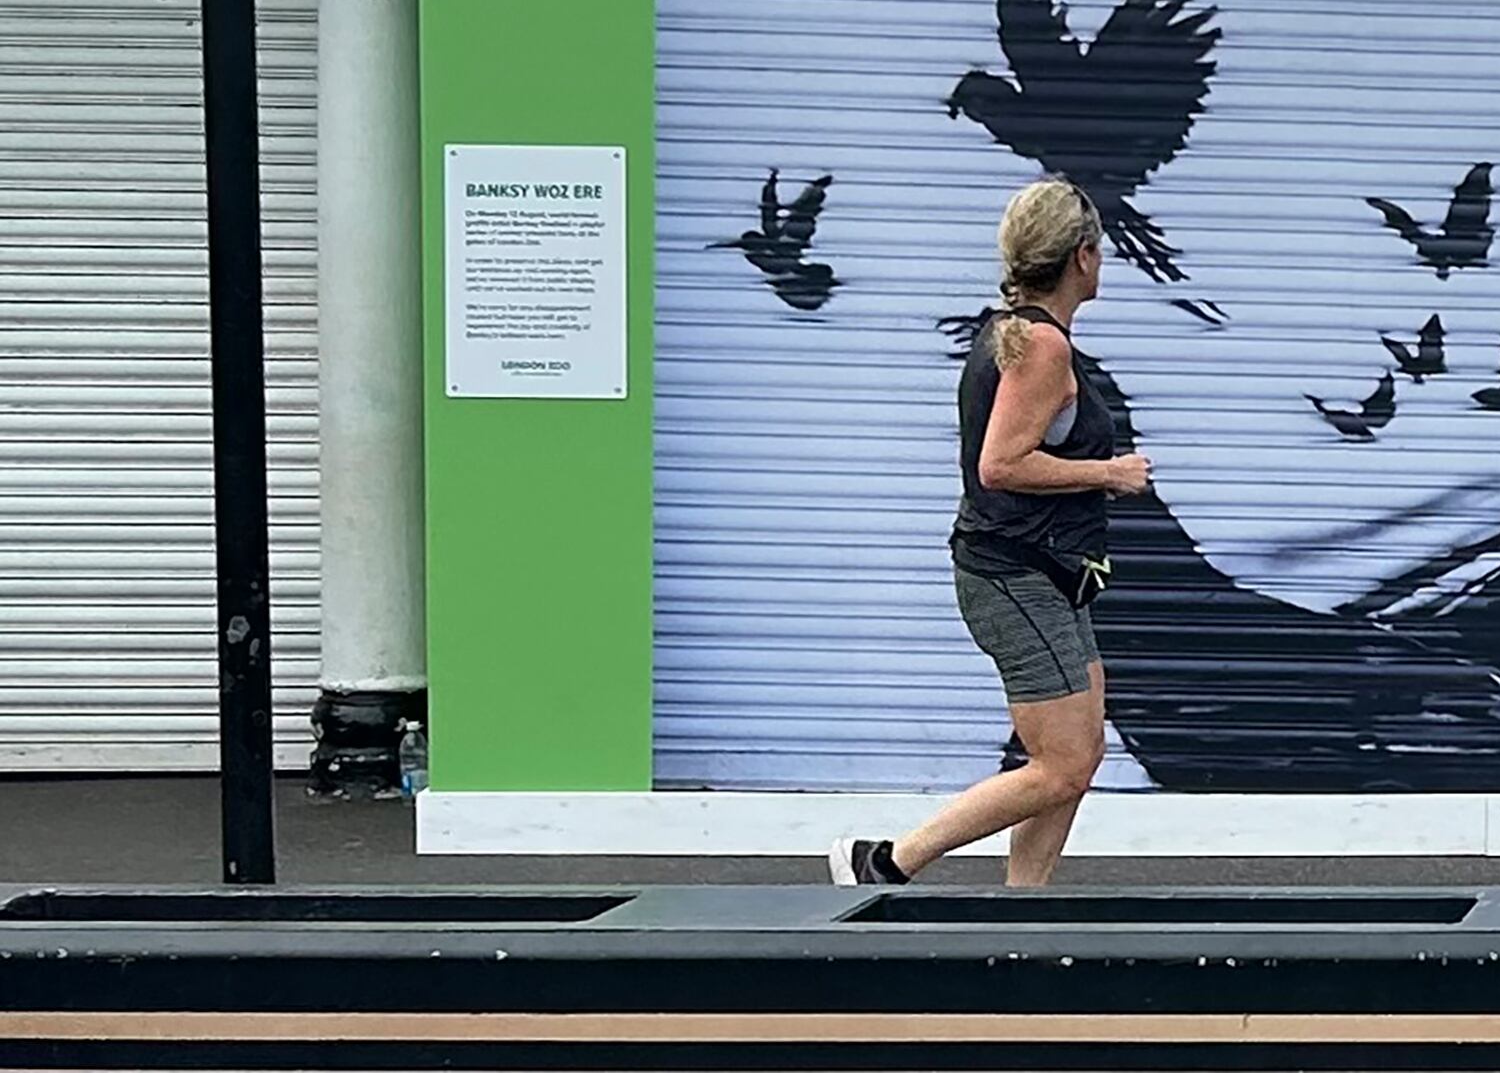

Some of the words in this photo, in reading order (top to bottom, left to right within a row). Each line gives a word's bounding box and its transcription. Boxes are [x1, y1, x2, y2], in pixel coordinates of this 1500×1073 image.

[465, 183, 530, 198] BANKSY
[534, 184, 569, 199] WOZ
[573, 185, 603, 199] ERE
